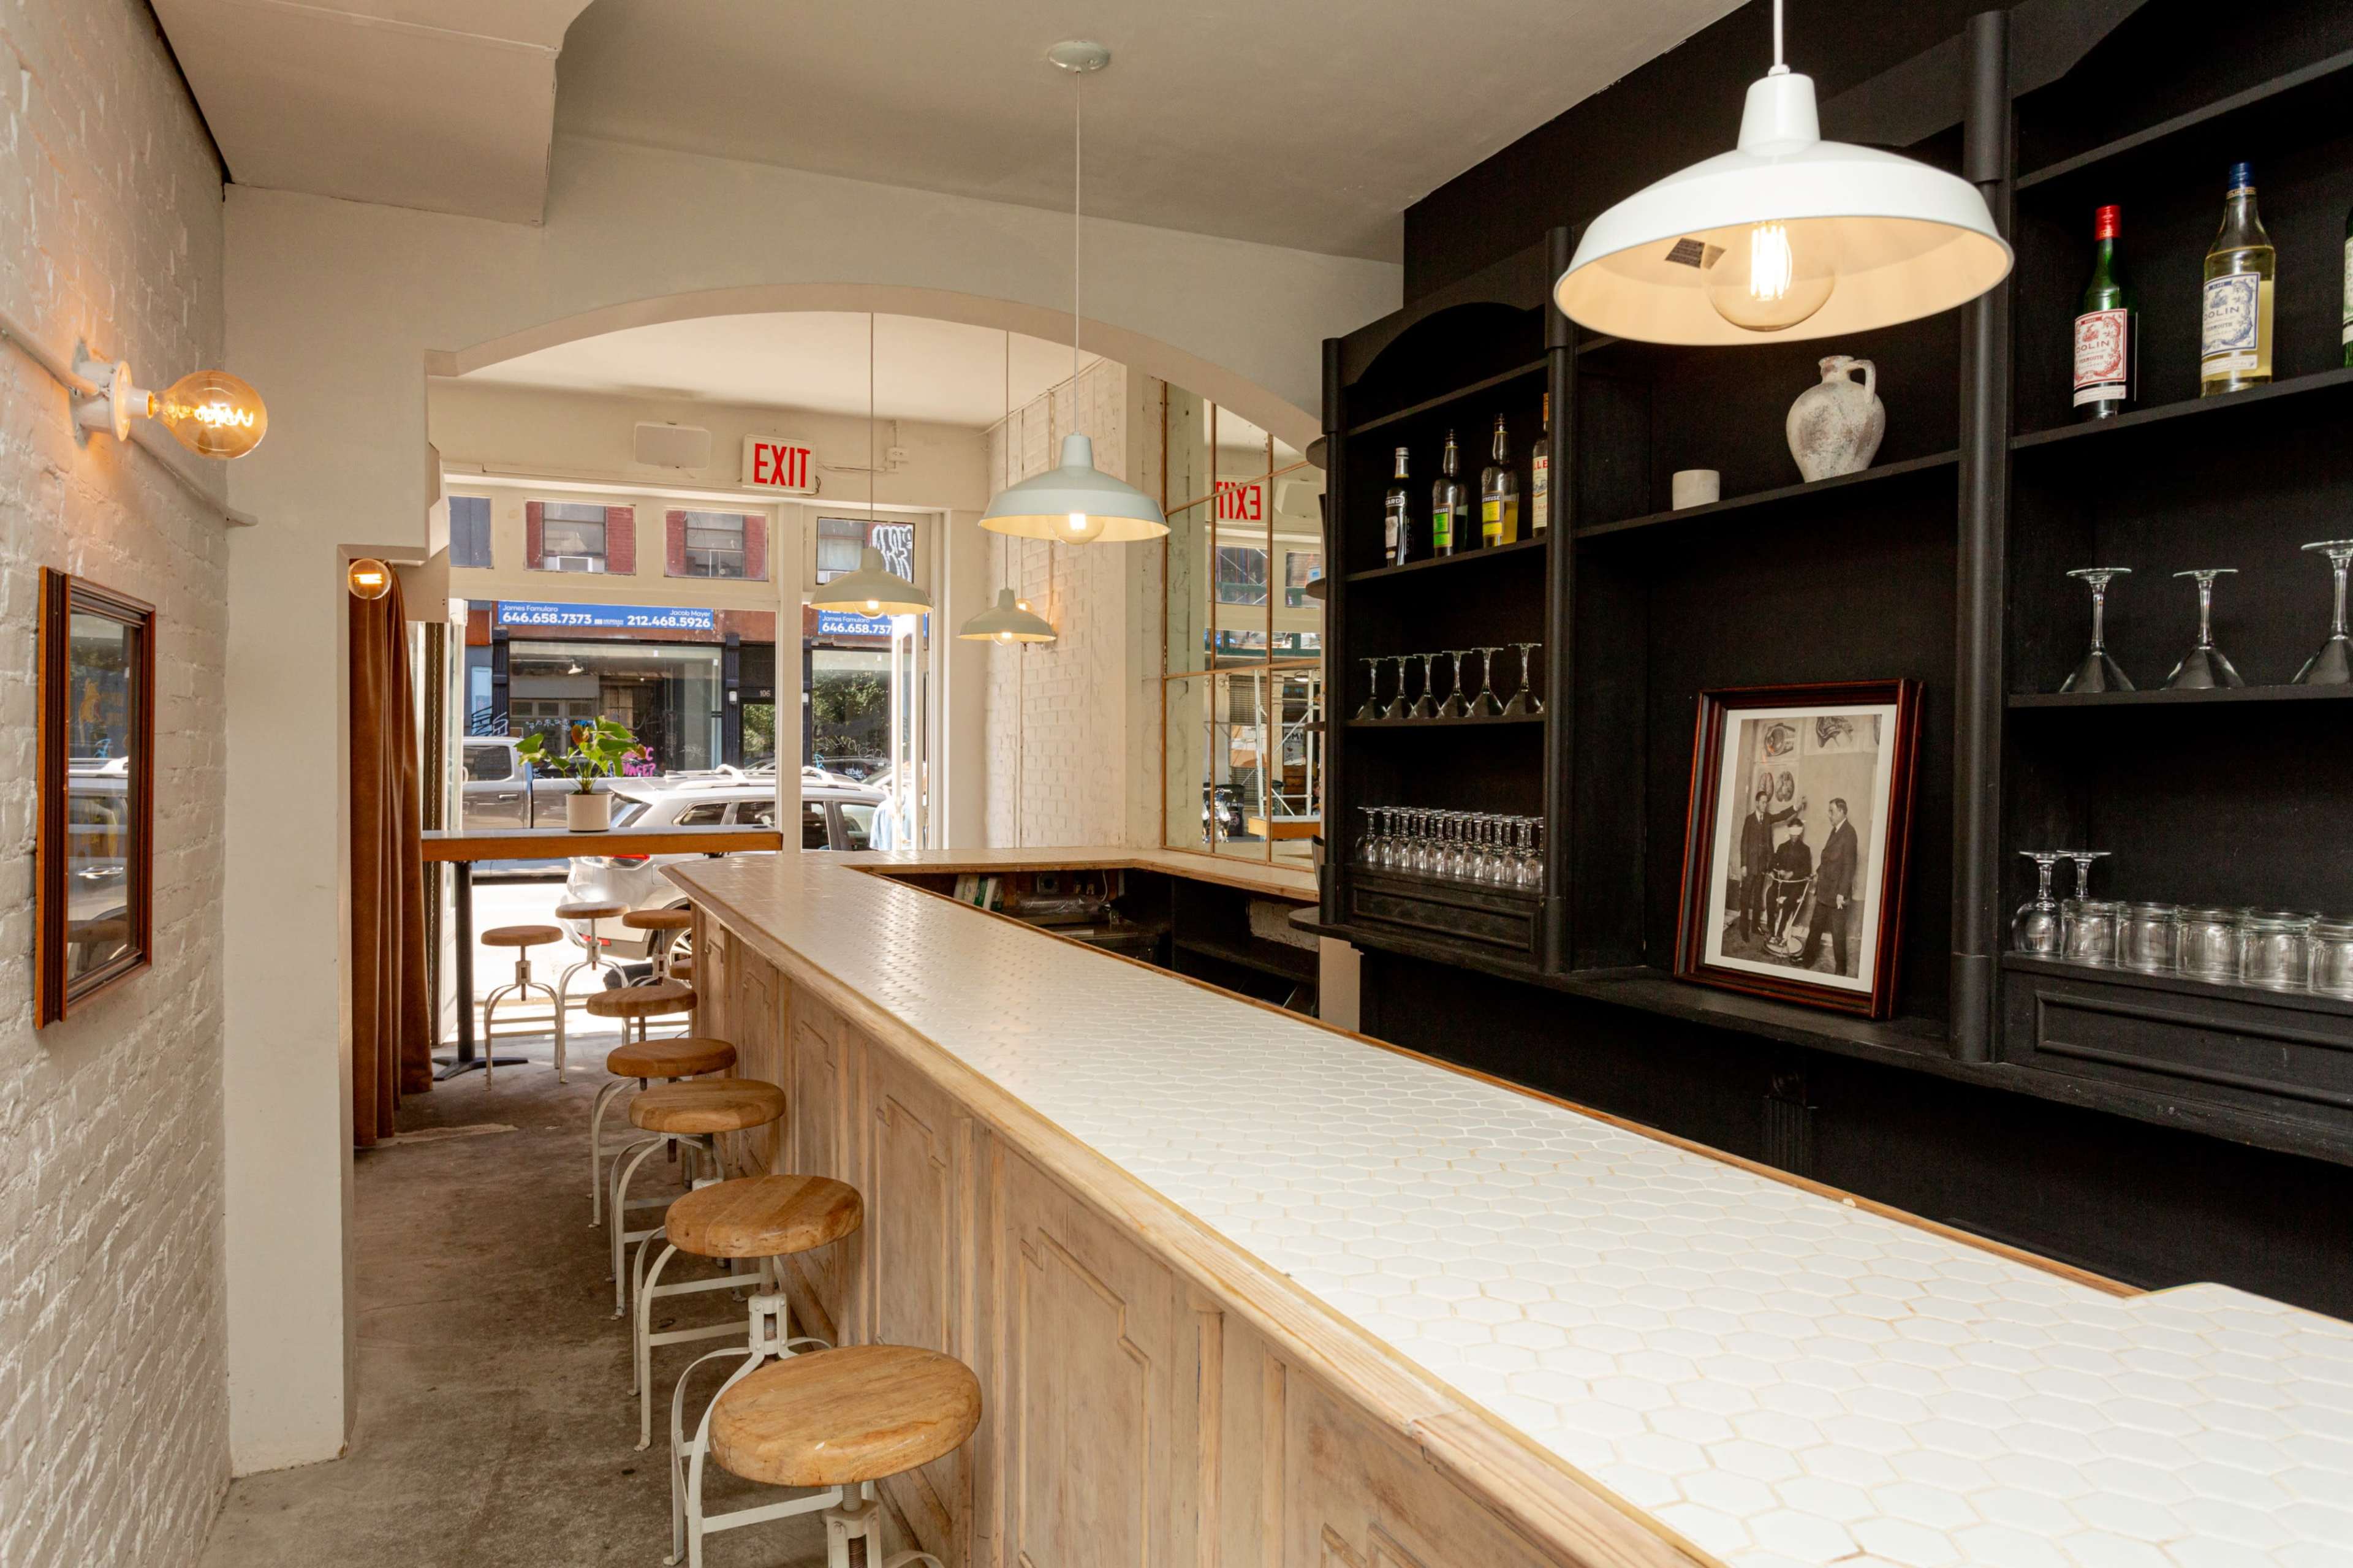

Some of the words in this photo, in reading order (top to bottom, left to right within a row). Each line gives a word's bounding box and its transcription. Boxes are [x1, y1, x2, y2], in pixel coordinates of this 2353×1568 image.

[754, 443, 810, 488] EXIT
[502, 612, 592, 624] 646.658.7373
[627, 615, 711, 627] 212.468.5926
[822, 623, 892, 634] 646.658.737
